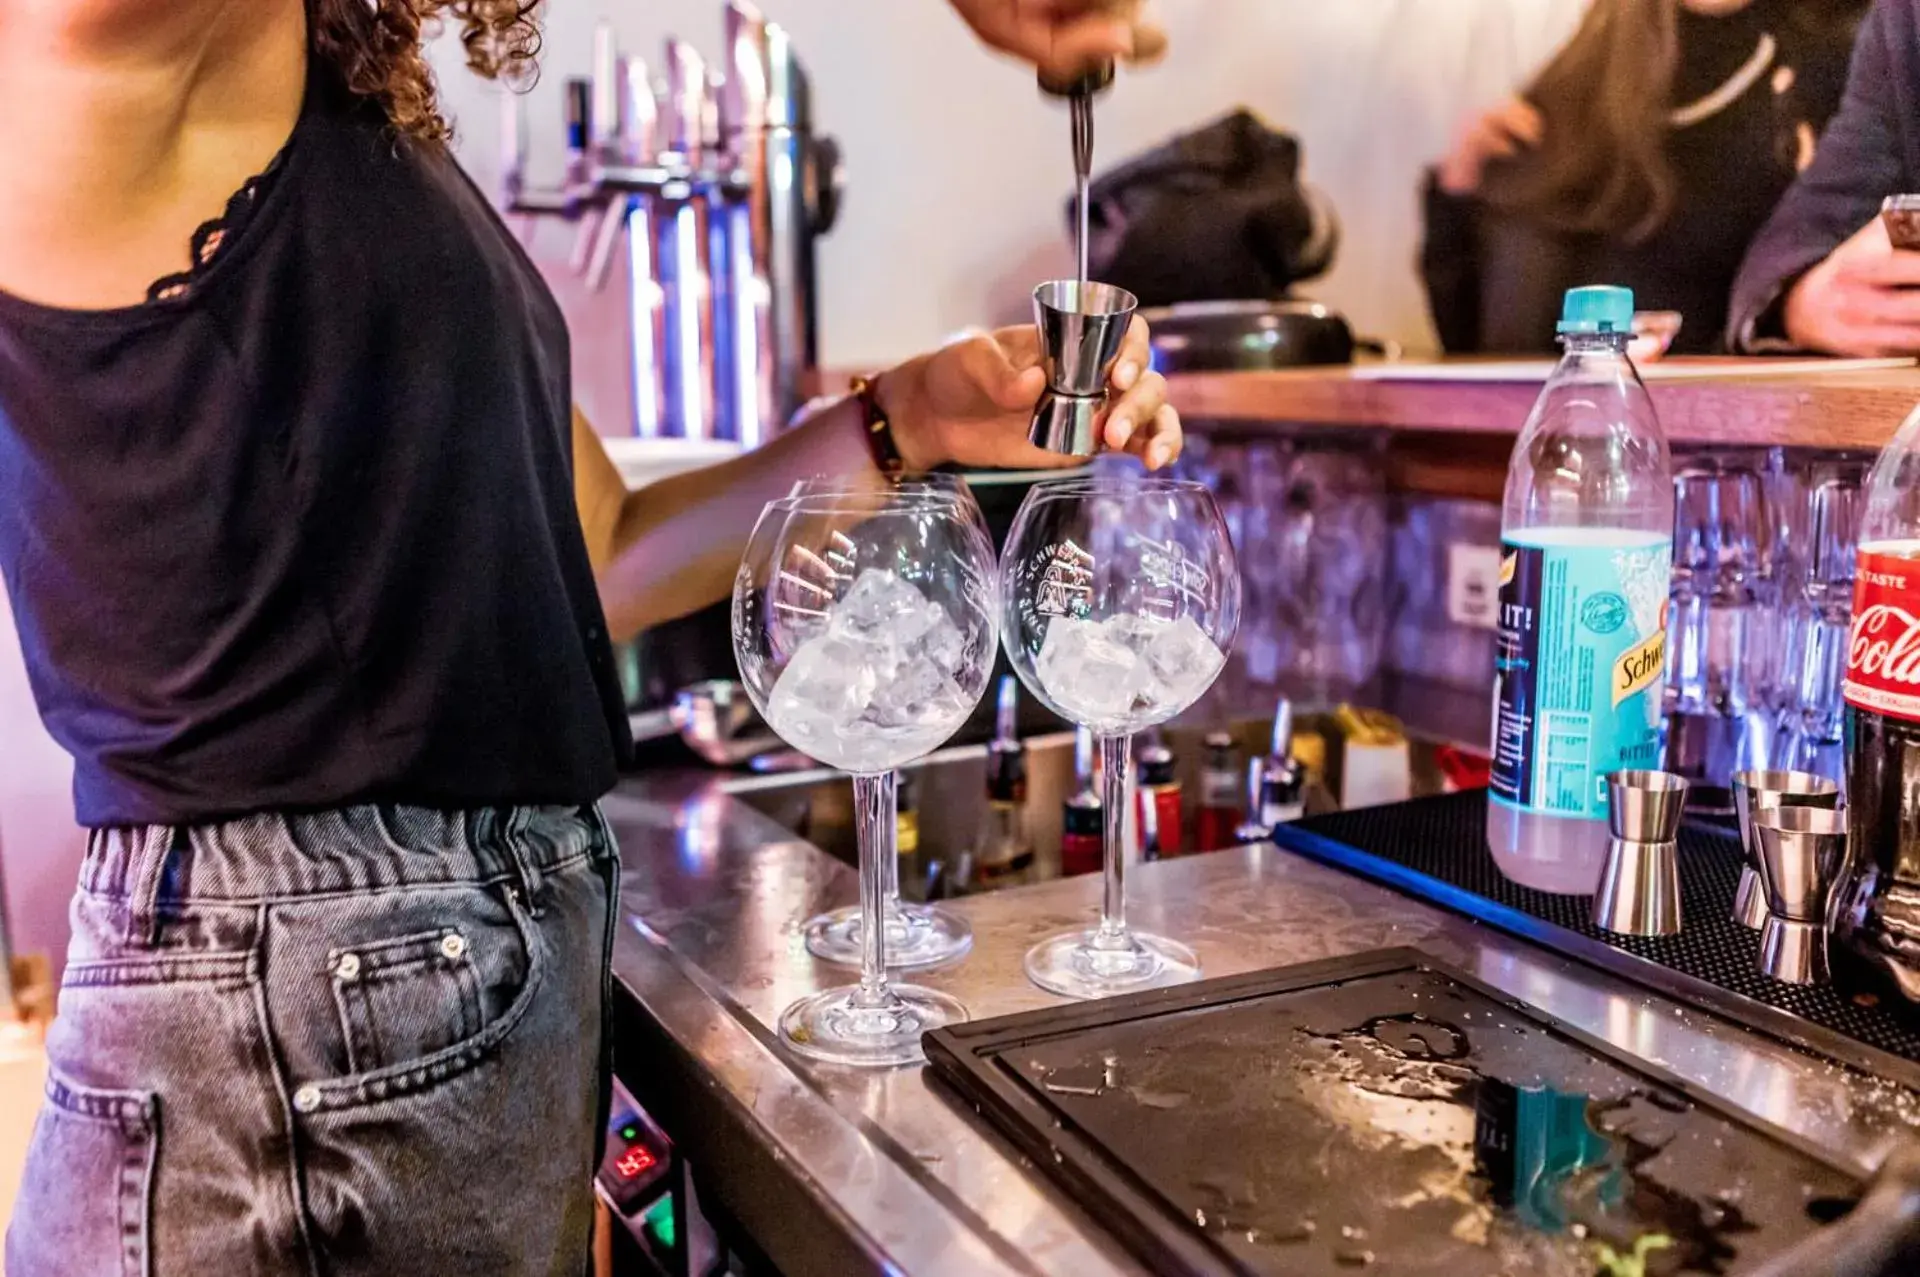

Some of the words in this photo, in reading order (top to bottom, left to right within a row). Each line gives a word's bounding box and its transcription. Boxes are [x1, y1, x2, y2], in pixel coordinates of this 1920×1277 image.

[1865, 570, 1906, 590] TASTE
[1505, 603, 1532, 631] IT!
[1847, 604, 1920, 684] Cola
